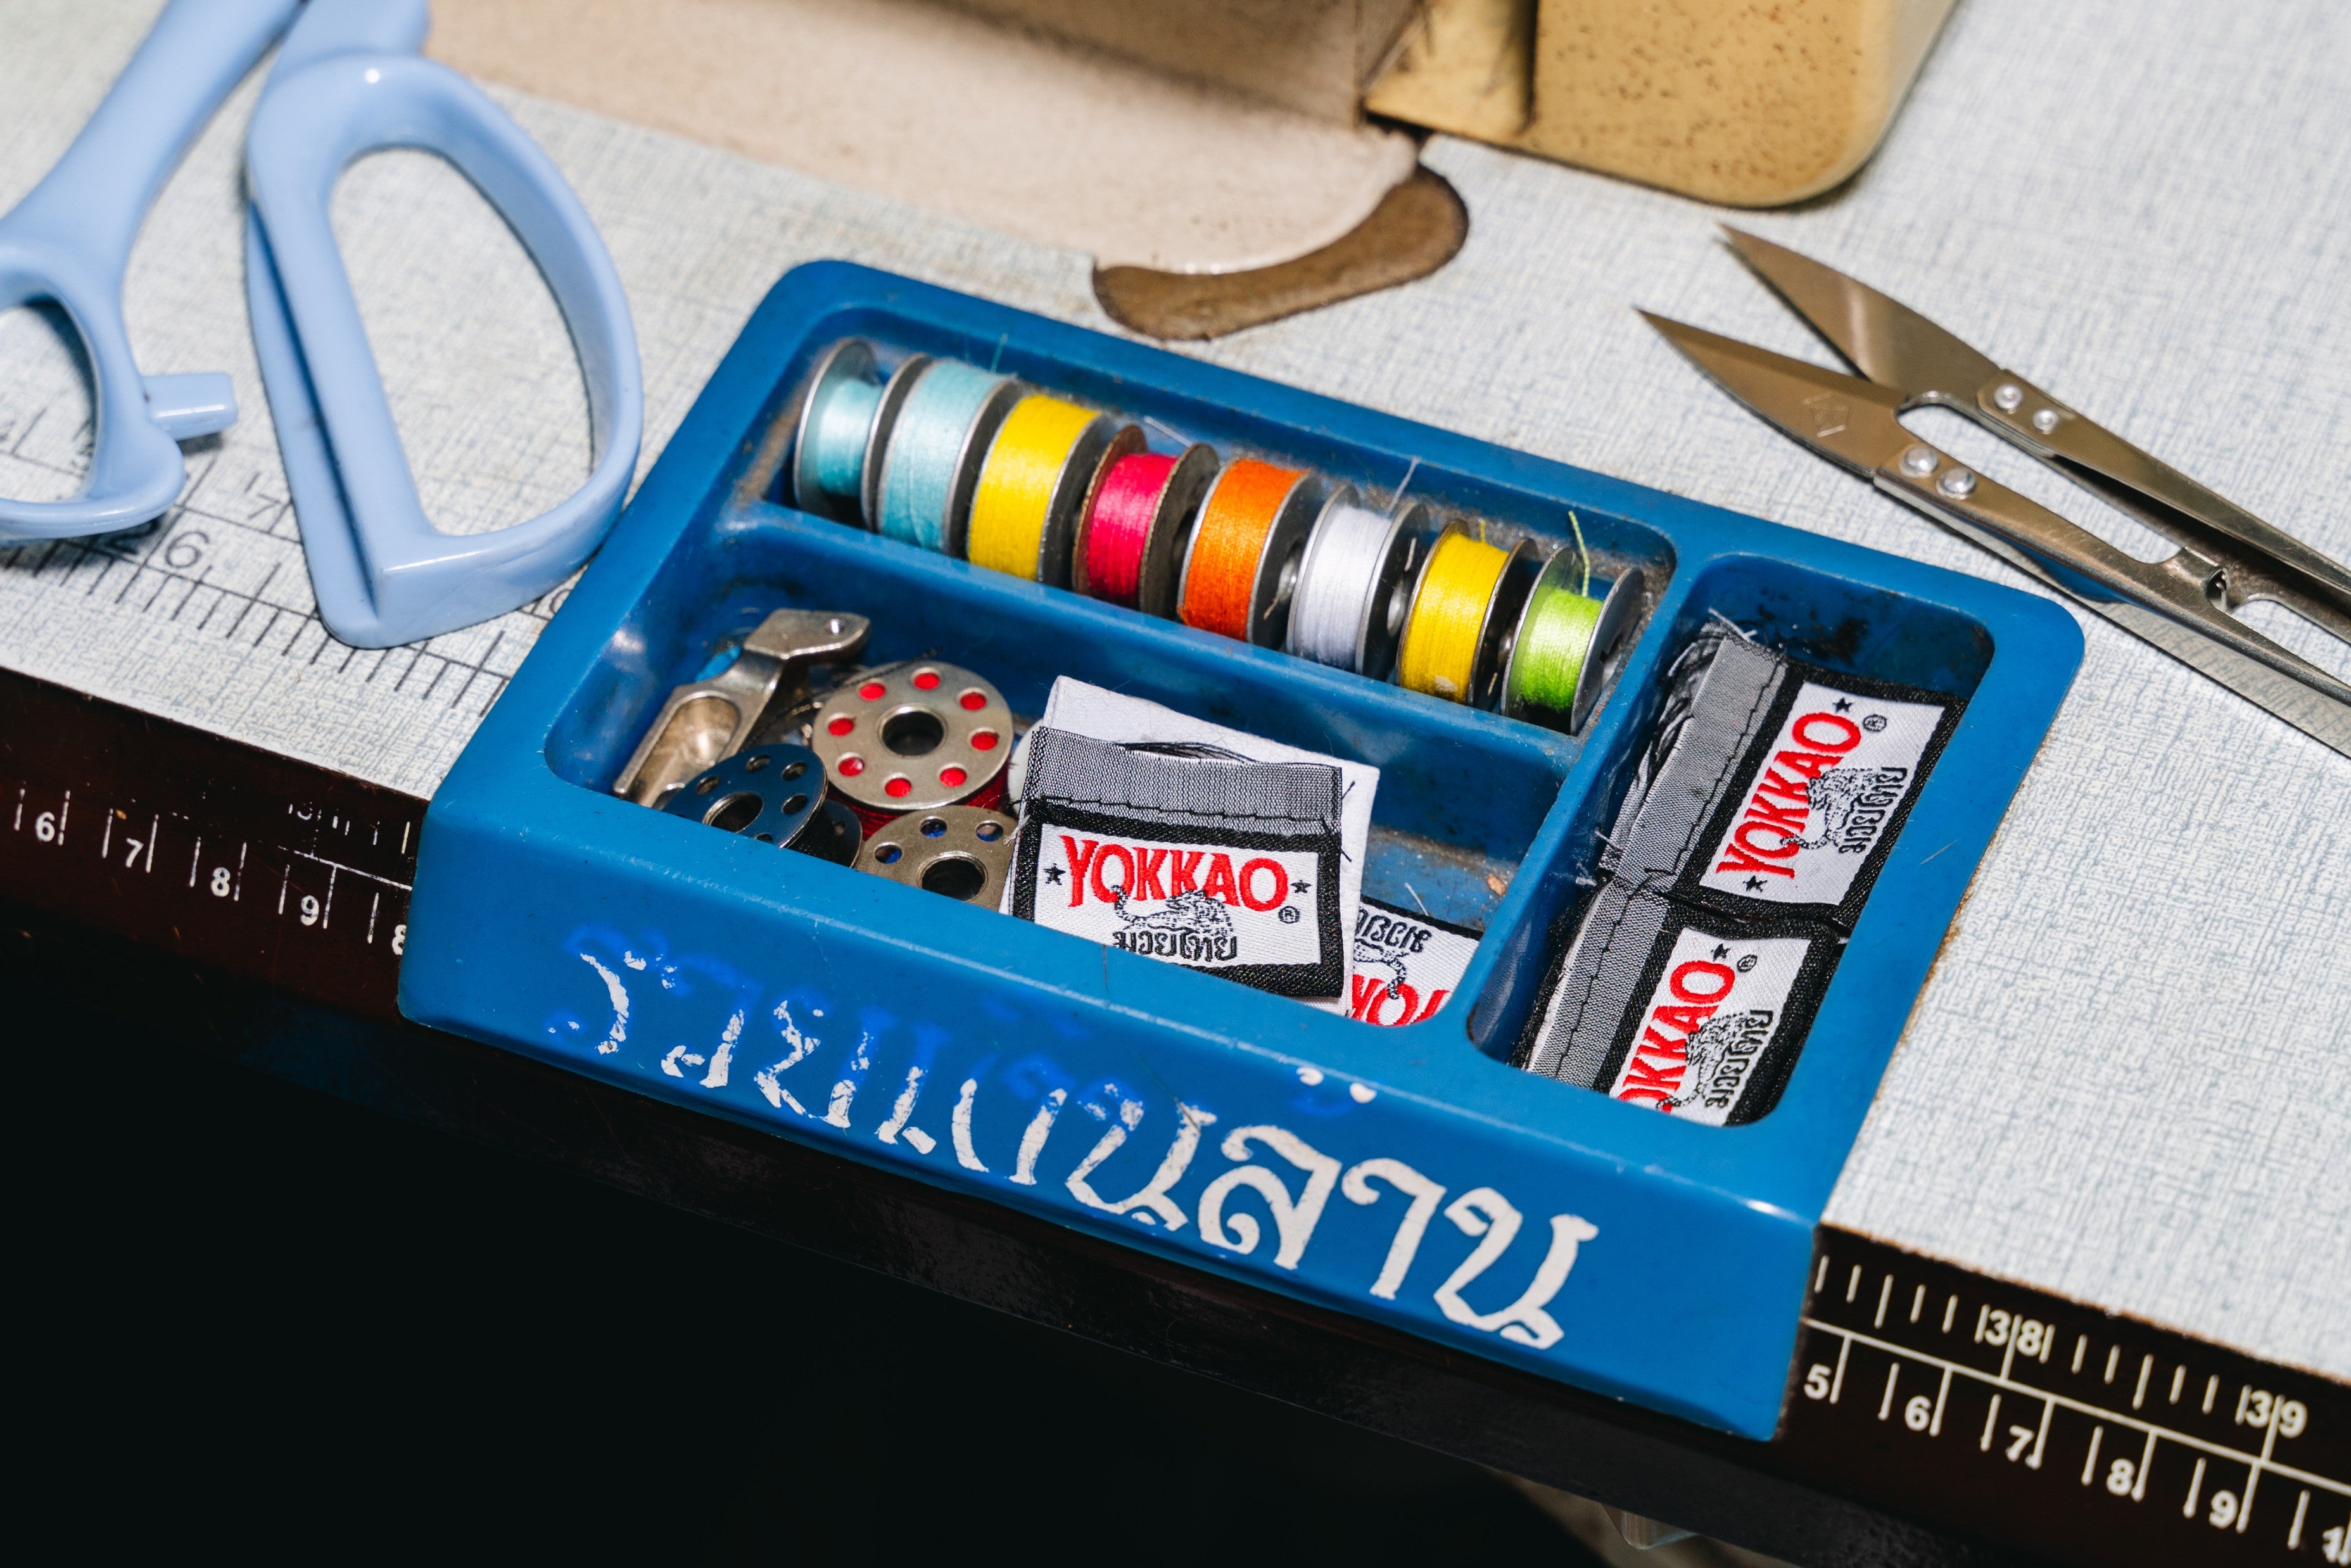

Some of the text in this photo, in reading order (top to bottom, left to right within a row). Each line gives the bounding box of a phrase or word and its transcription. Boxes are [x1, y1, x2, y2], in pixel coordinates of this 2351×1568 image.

[1716, 711, 1862, 880] YOKKAO
[34, 811, 55, 842] 6
[124, 838, 144, 868] 7
[211, 867, 231, 897] 8
[300, 894, 319, 926] 9
[1060, 835, 1288, 912] YOKKAO
[1113, 930, 1237, 961] มวยไทย
[1804, 1364, 1832, 1400] 5
[1905, 1396, 1932, 1431] 6
[2006, 1427, 2035, 1462] 7
[2107, 1458, 2136, 1496] 8
[2208, 1489, 2238, 1529] 9
